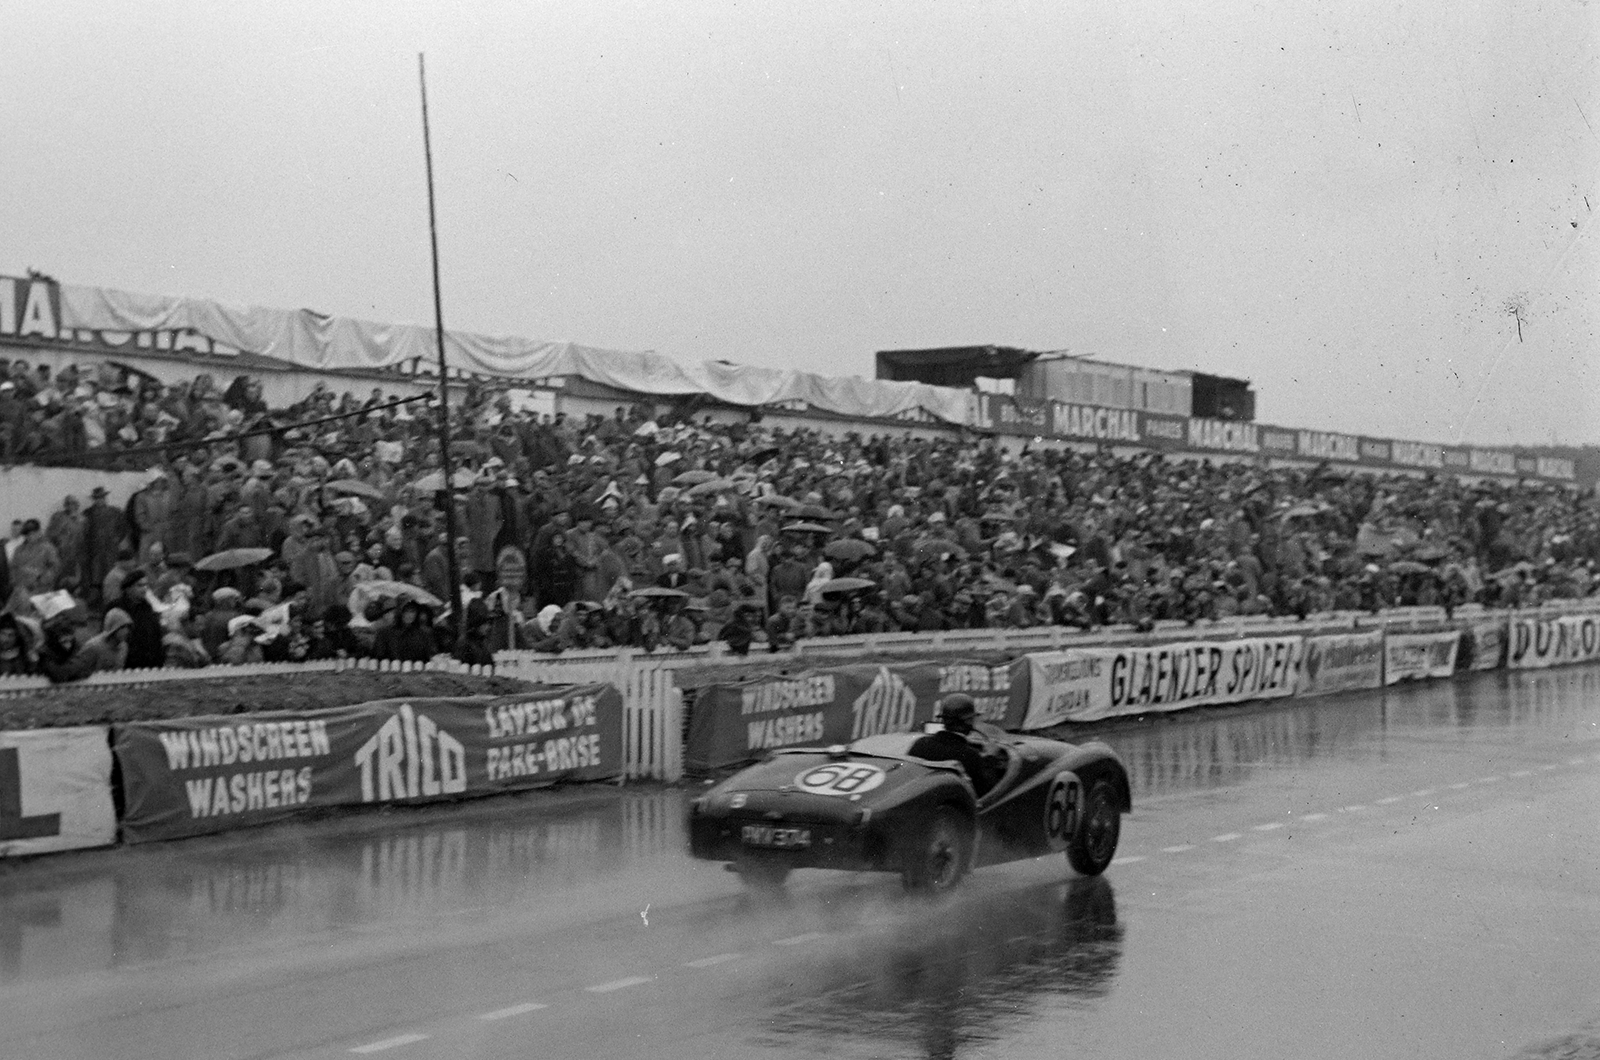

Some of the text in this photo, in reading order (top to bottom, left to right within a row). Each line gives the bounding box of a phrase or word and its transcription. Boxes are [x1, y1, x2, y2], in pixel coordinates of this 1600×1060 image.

[1053, 403, 1140, 441] MARCHAL
[1188, 417, 1259, 451] MARCHAL
[741, 674, 835, 715] WINDSCREEN
[1111, 647, 1222, 706] GLAENZER
[159, 719, 330, 770] WINDSCREEN
[747, 711, 824, 749] WASHERS
[487, 734, 601, 781] PARE-BRISE
[803, 764, 880, 792] 68
[185, 766, 313, 819] WASHERS
[1048, 781, 1078, 839] 68
